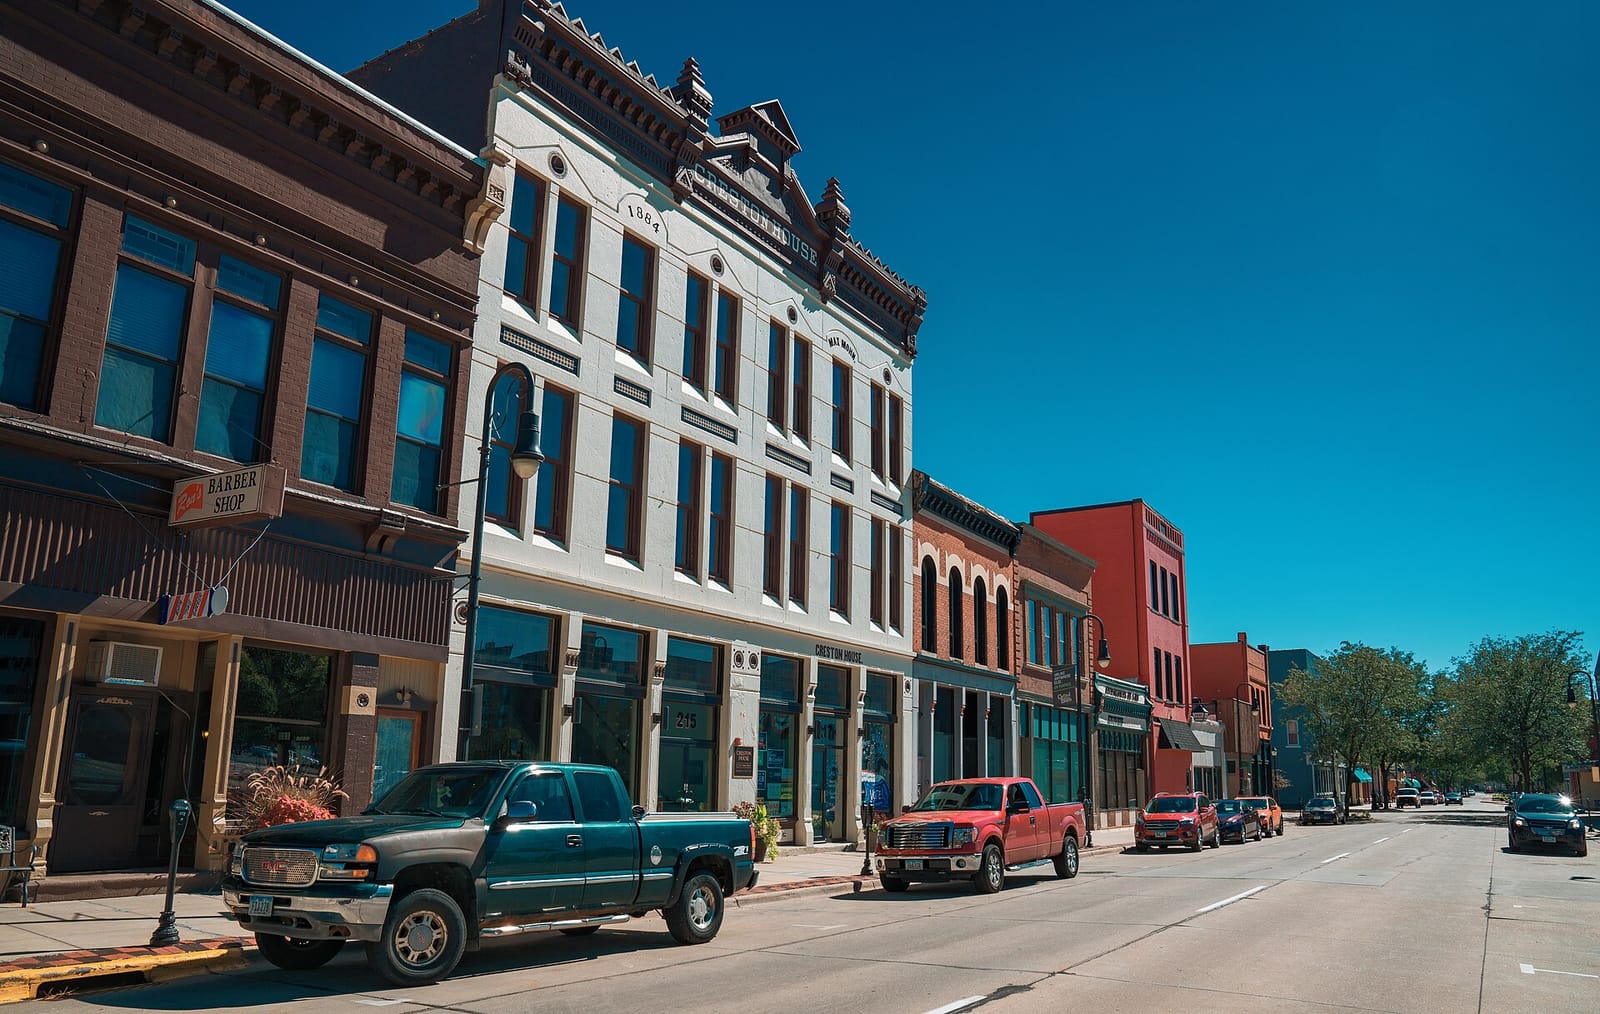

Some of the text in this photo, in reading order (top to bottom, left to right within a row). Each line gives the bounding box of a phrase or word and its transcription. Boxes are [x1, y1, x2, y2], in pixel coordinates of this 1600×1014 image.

[628, 204, 660, 234] 1884
[694, 163, 818, 267] CRESTON HOUSE
[828, 336, 841, 348] MAX
[208, 470, 257, 495] BARBER
[213, 493, 245, 514] SHOP
[815, 643, 843, 661] CRESTON
[675, 712, 697, 729] 215
[262, 861, 287, 871] GMC
